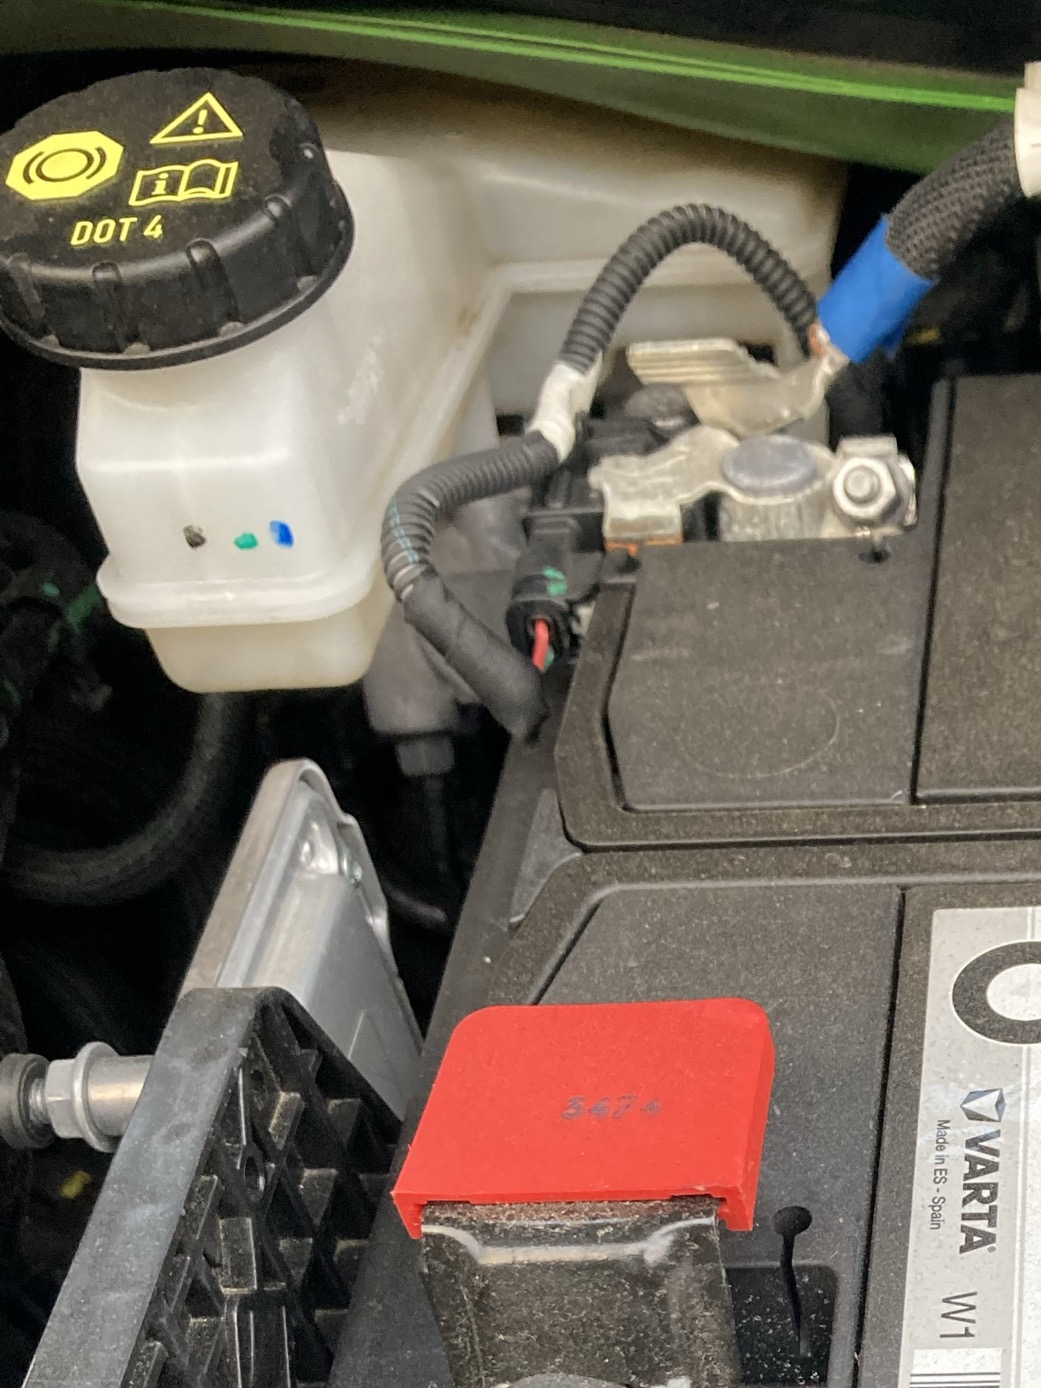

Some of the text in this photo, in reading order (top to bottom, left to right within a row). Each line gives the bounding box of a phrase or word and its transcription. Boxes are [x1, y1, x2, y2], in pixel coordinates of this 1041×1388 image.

[70, 214, 163, 246] DOT 4
[935, 1119, 951, 1152] Made
[934, 1154, 949, 1165] in
[932, 1168, 948, 1185] ES
[959, 1129, 1001, 1254] VARTA
[928, 1196, 946, 1230] Spain
[939, 1291, 978, 1339] W1
